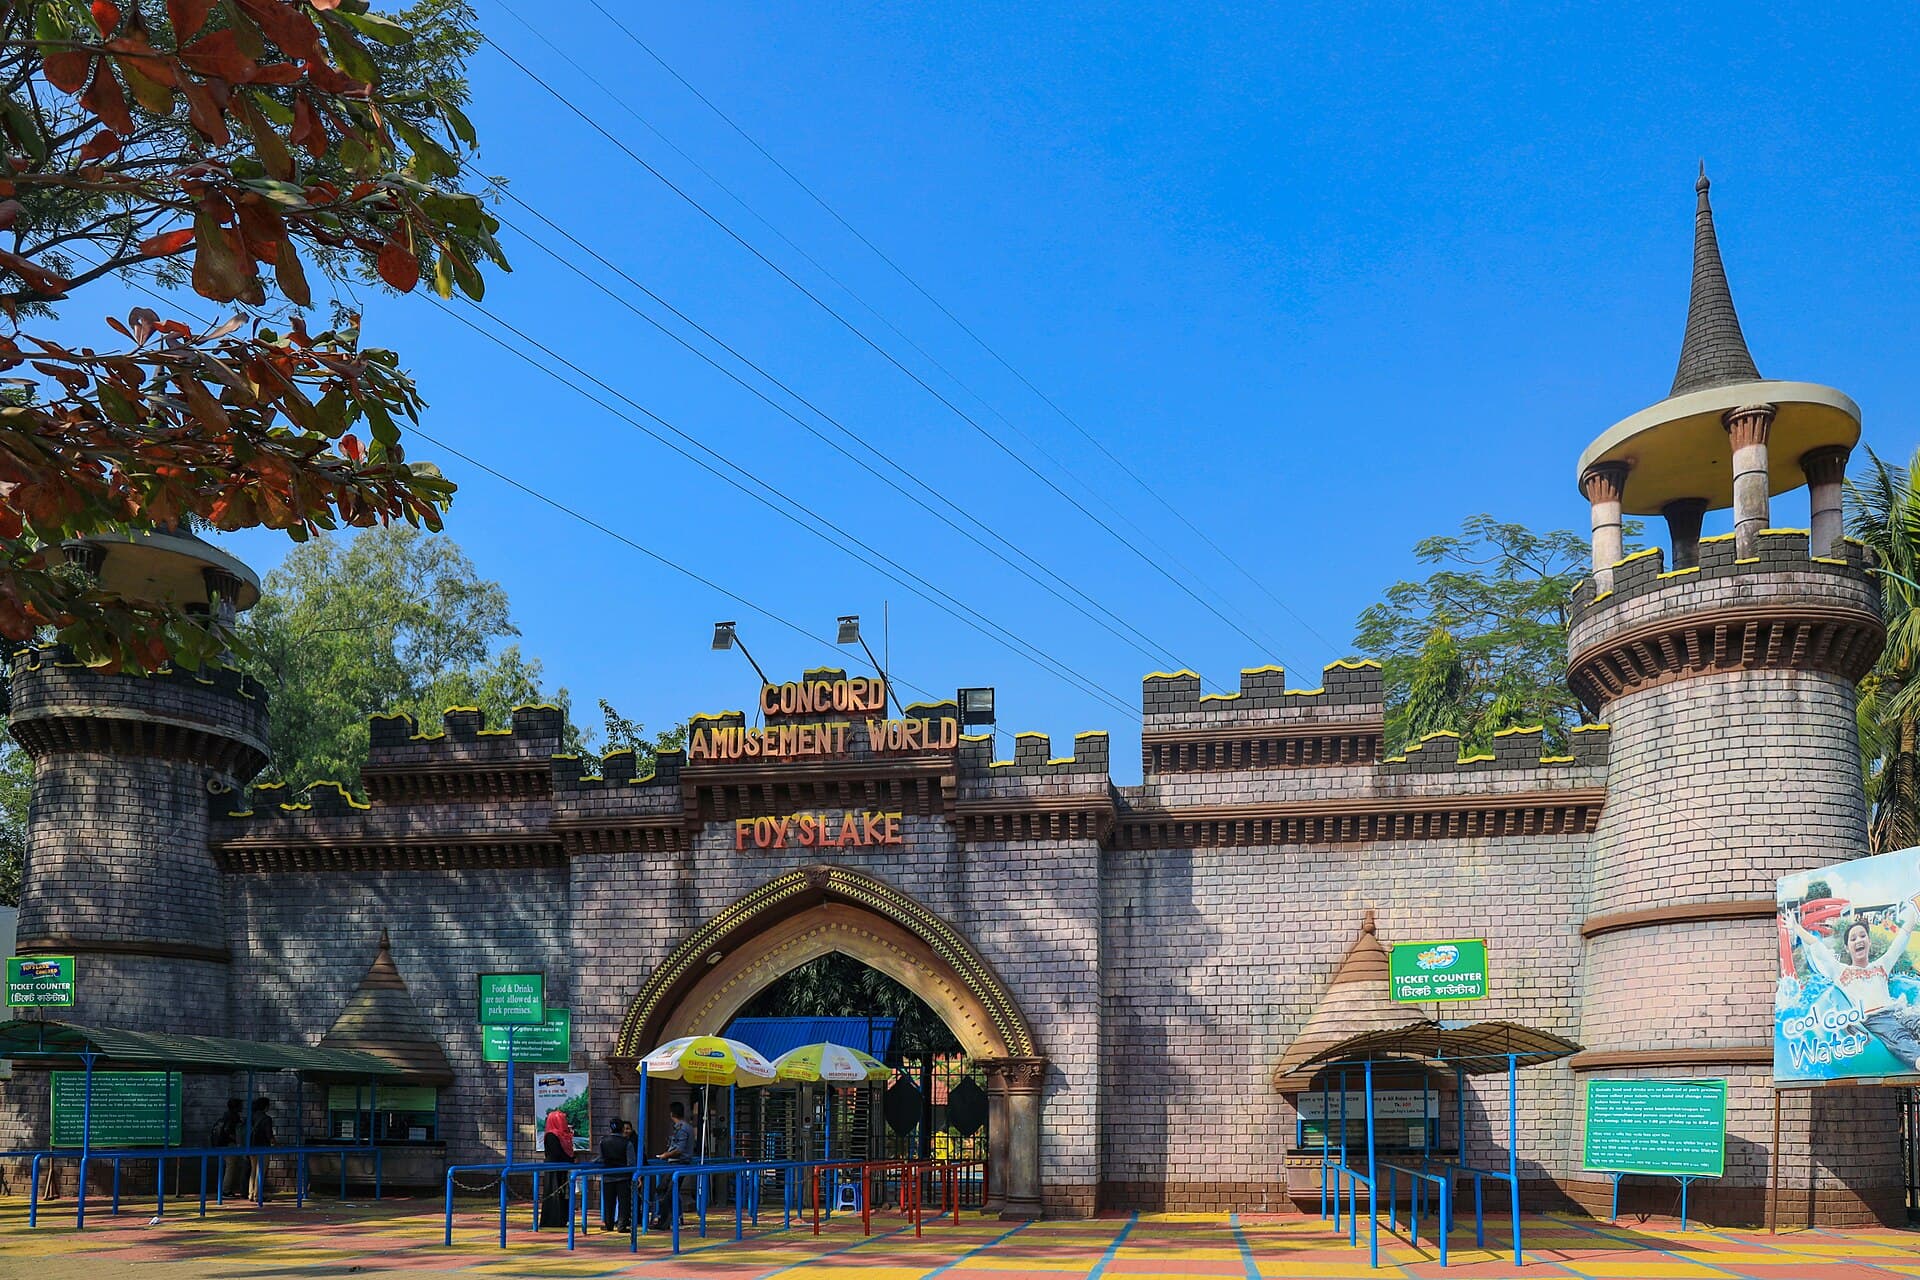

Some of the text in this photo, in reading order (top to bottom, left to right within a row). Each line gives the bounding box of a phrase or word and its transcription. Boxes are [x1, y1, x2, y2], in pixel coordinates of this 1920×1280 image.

[760, 678, 887, 716] CONCORD
[688, 716, 959, 760] AMUSEMENT WORLD
[1395, 972, 1482, 984] TICKET COUNTER
[36, 982, 71, 990] COUNTER
[492, 984, 534, 993] Food & Drinks
[1397, 985, 1431, 998] (টিকেট
[486, 996, 494, 1004] are
[507, 995, 531, 1004] allowed
[533, 995, 539, 1004] at
[488, 1005, 532, 1016] park premises.
[1785, 999, 1865, 1036] Cool Cool
[1790, 1032, 1868, 1068] Water
